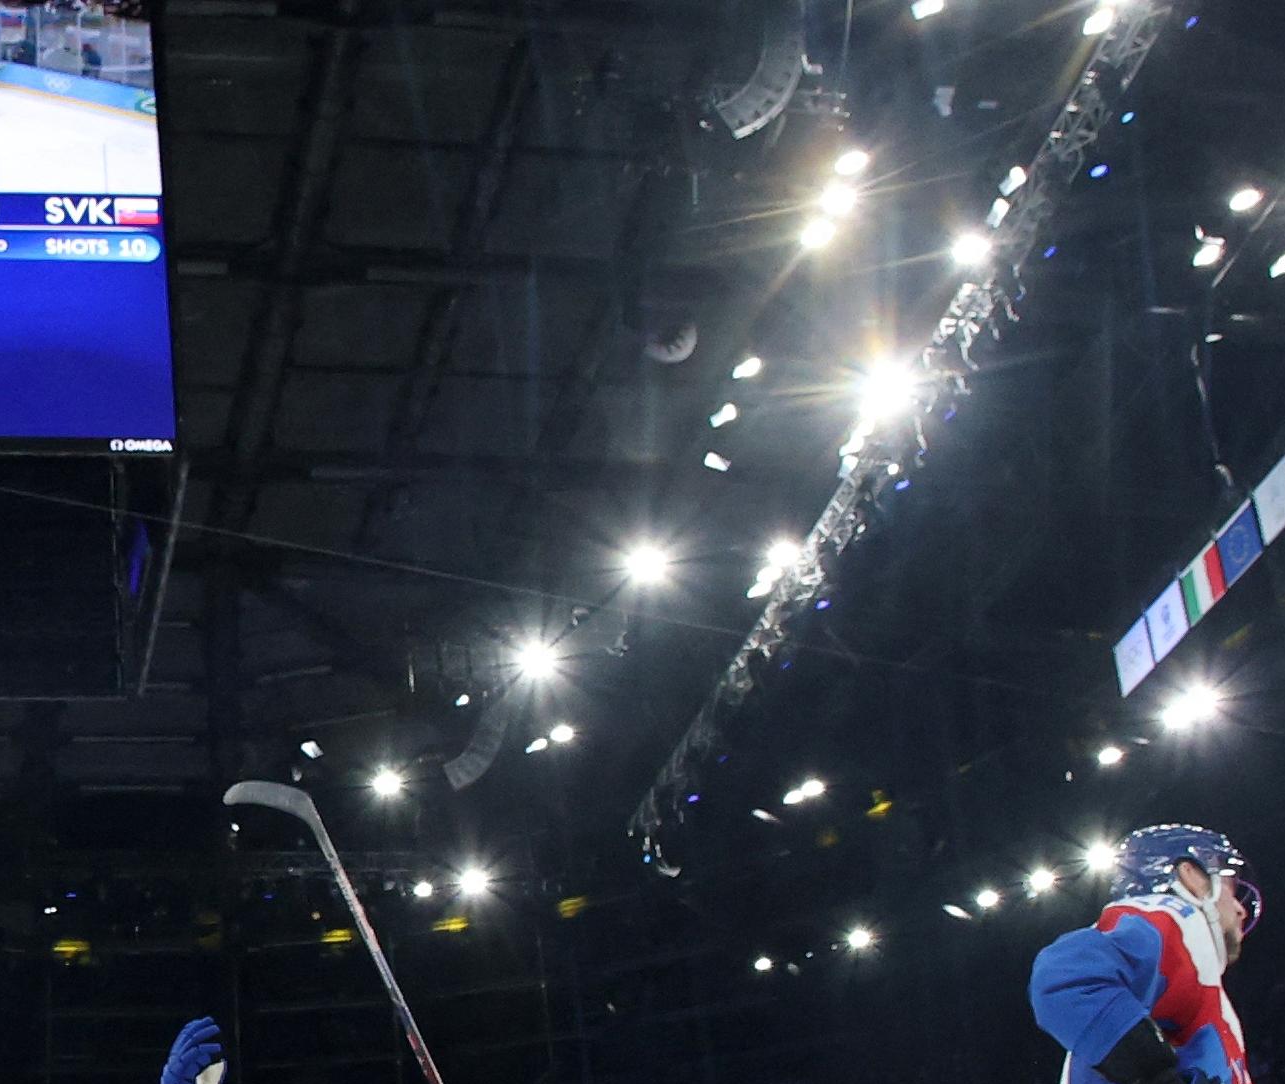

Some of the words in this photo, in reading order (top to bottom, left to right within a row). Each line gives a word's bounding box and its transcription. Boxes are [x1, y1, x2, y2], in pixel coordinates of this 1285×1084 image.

[45, 197, 115, 224] SVK
[45, 239, 109, 256] SHOTS
[119, 239, 147, 256] 10
